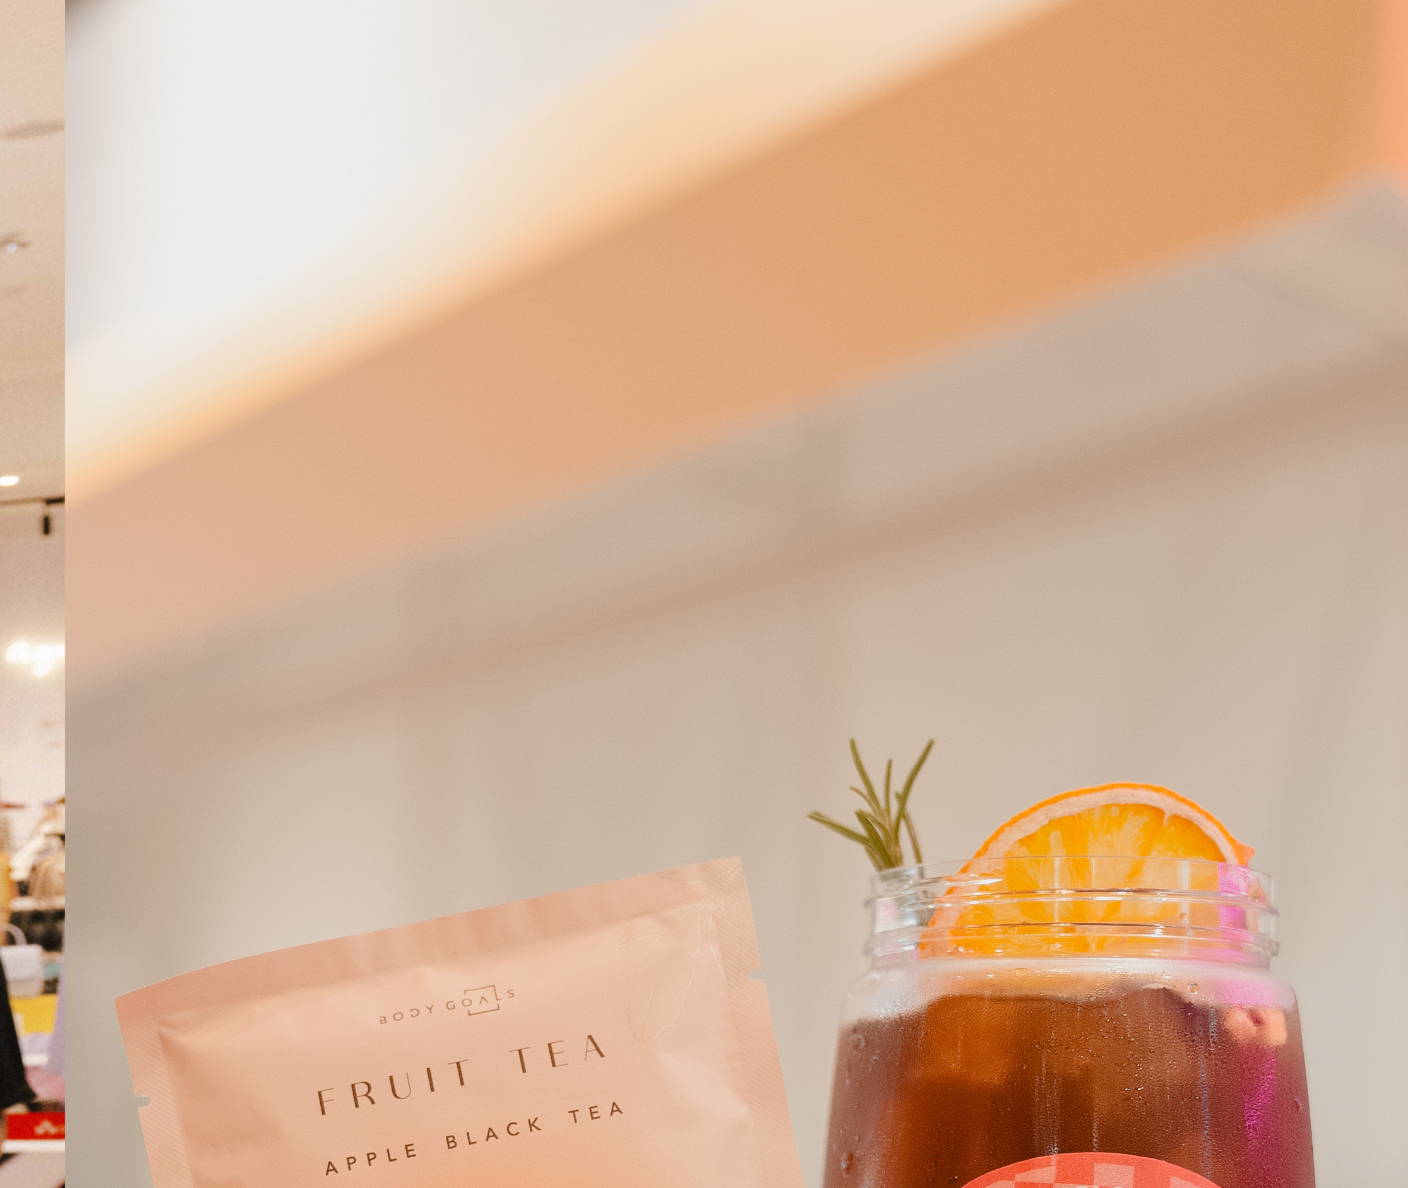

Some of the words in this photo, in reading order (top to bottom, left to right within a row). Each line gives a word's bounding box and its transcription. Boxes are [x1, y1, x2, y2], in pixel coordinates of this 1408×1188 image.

[317, 1059, 469, 1116] FRUIT
[509, 1034, 605, 1074] TEA
[325, 1143, 417, 1176] APPLE
[445, 1117, 542, 1149] BLACK
[568, 1101, 624, 1124] TEA
